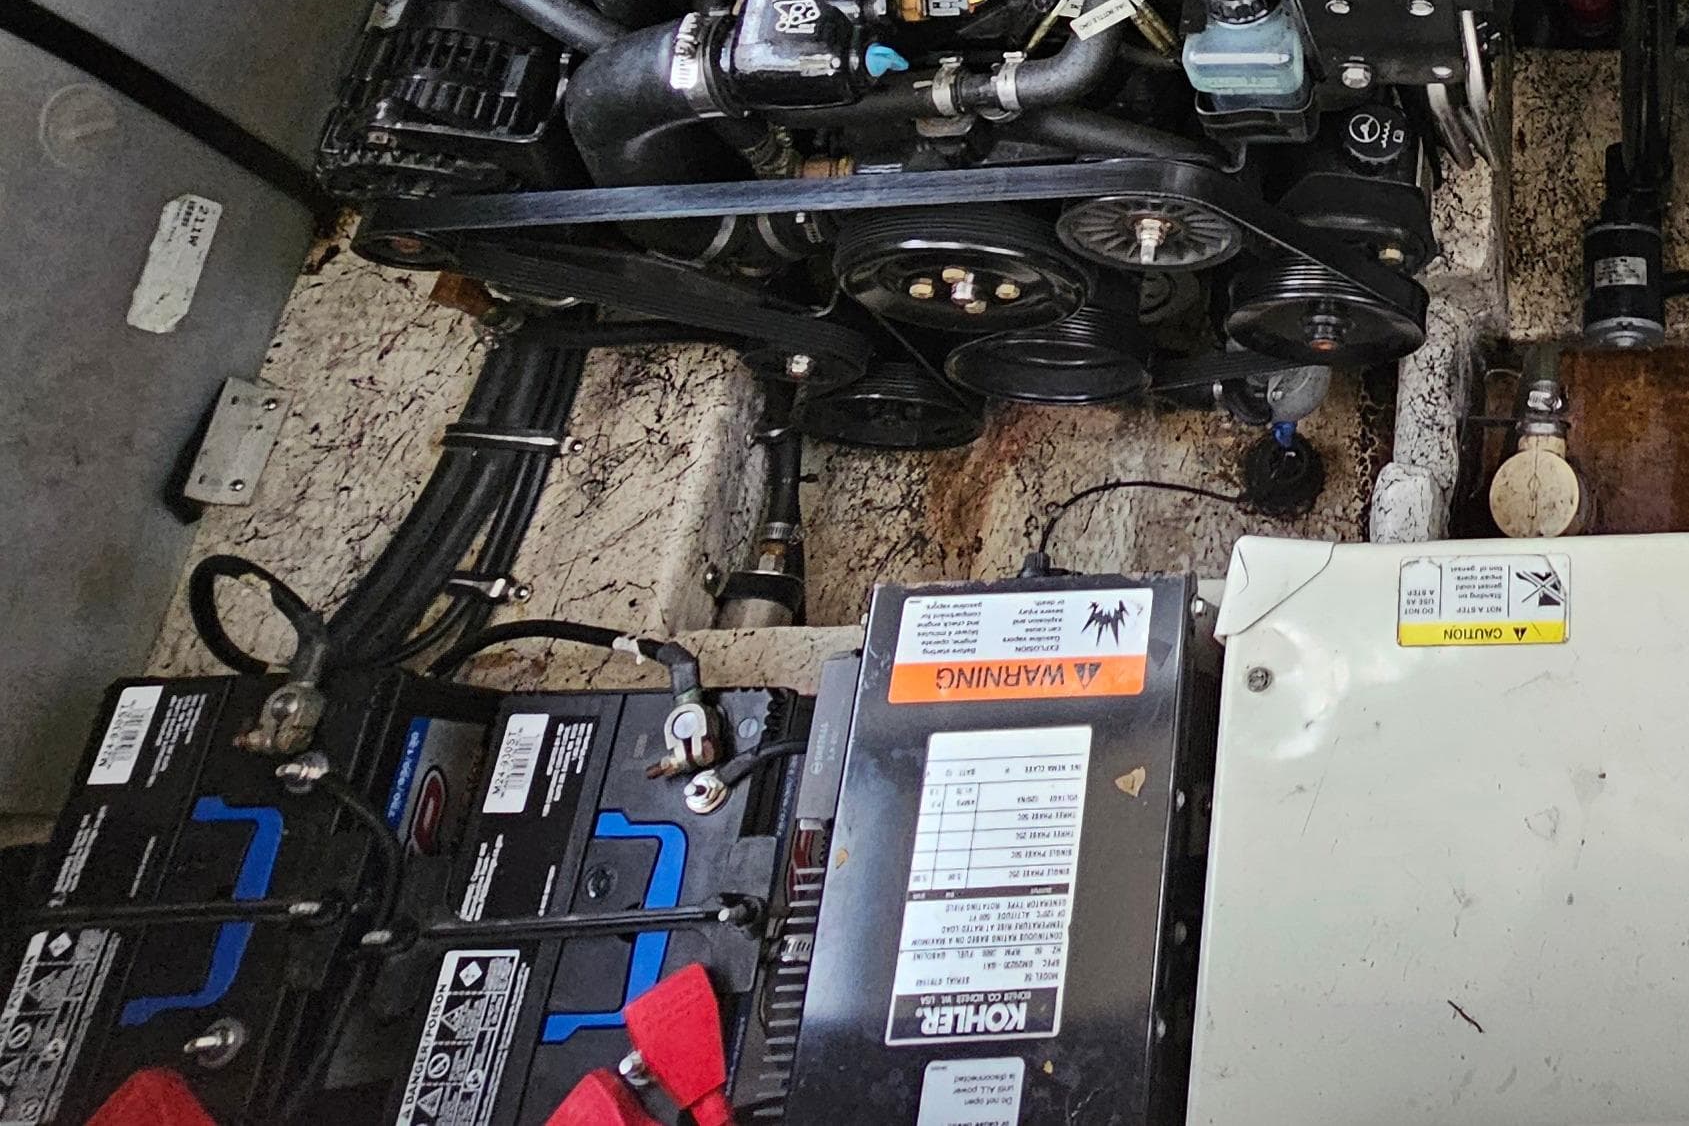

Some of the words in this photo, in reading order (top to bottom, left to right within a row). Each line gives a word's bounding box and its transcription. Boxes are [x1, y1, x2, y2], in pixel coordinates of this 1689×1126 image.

[1422, 606, 1434, 614] DO
[1443, 627, 1503, 640] CAUTION
[1014, 644, 1060, 652] EXPLOSION
[936, 663, 1064, 690] WARNING
[1029, 831, 1050, 839] PHASE
[1024, 850, 1046, 858] PHASE
[1050, 848, 1072, 856] SINGLE
[1022, 869, 1044, 877] PHASE
[1048, 868, 1070, 876] SINGLE
[966, 902, 1000, 910] ROTATING
[1006, 901, 1024, 909] TYPE
[1026, 898, 1066, 907] GENERATOR
[962, 924, 984, 932] RATED
[1014, 921, 1064, 930] TEMPERATURE
[940, 926, 960, 934] LOAD
[966, 934, 988, 943] BASED
[992, 933, 1017, 942] RATING
[1020, 932, 1062, 940] CONTINUOUS
[911, 936, 946, 946] MAXIMUM
[957, 950, 973, 958] FUEL
[1004, 948, 1021, 956] RPM
[1042, 958, 1060, 966] SPEC
[946, 976, 970, 984] SERIAL
[956, 993, 984, 1004] KOHLER
[1004, 992, 1032, 1000] KOHLER
[920, 996, 936, 1005] USA
